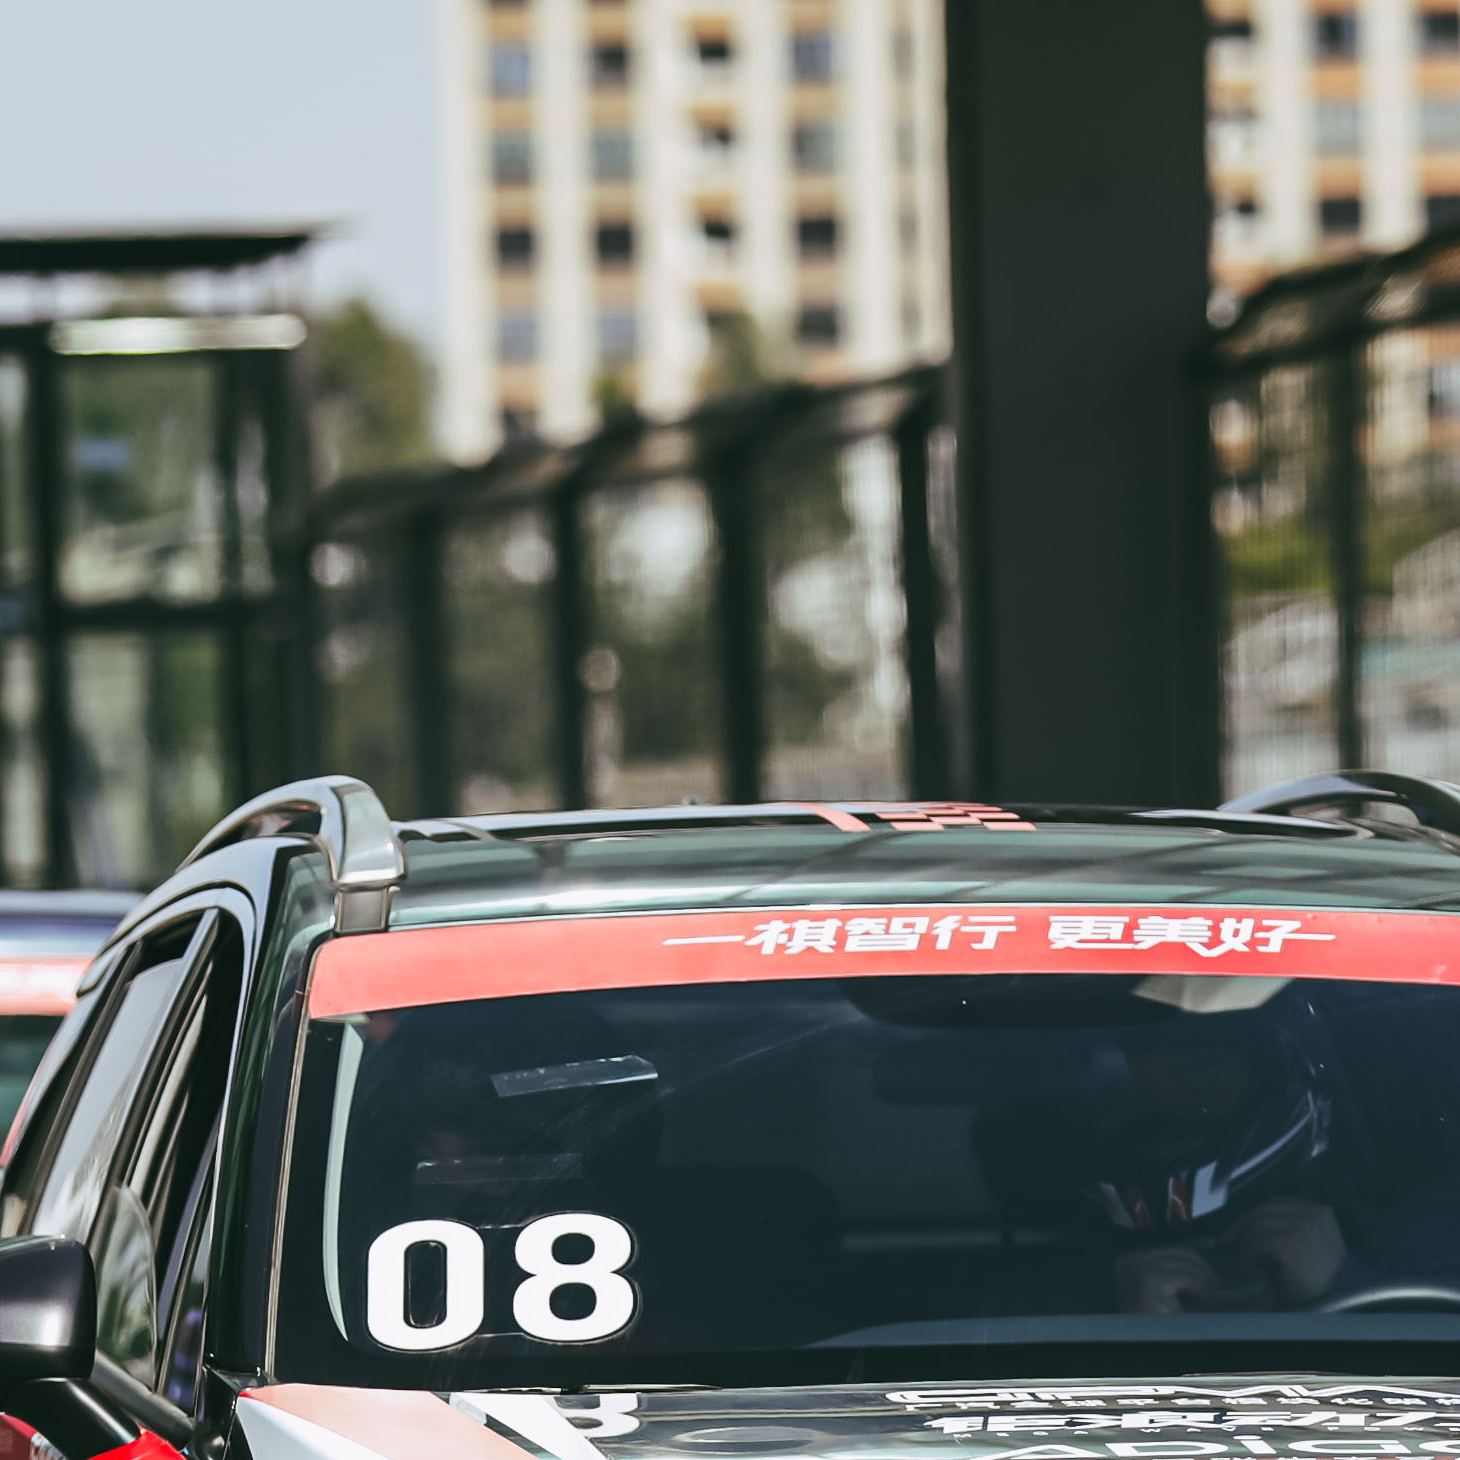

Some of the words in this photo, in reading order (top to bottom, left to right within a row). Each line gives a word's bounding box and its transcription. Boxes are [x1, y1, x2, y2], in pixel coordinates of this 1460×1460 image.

[662, 915, 1016, 956] 一祺智行
[1047, 915, 1336, 958] 更美好
[367, 1212, 634, 1350] 08
